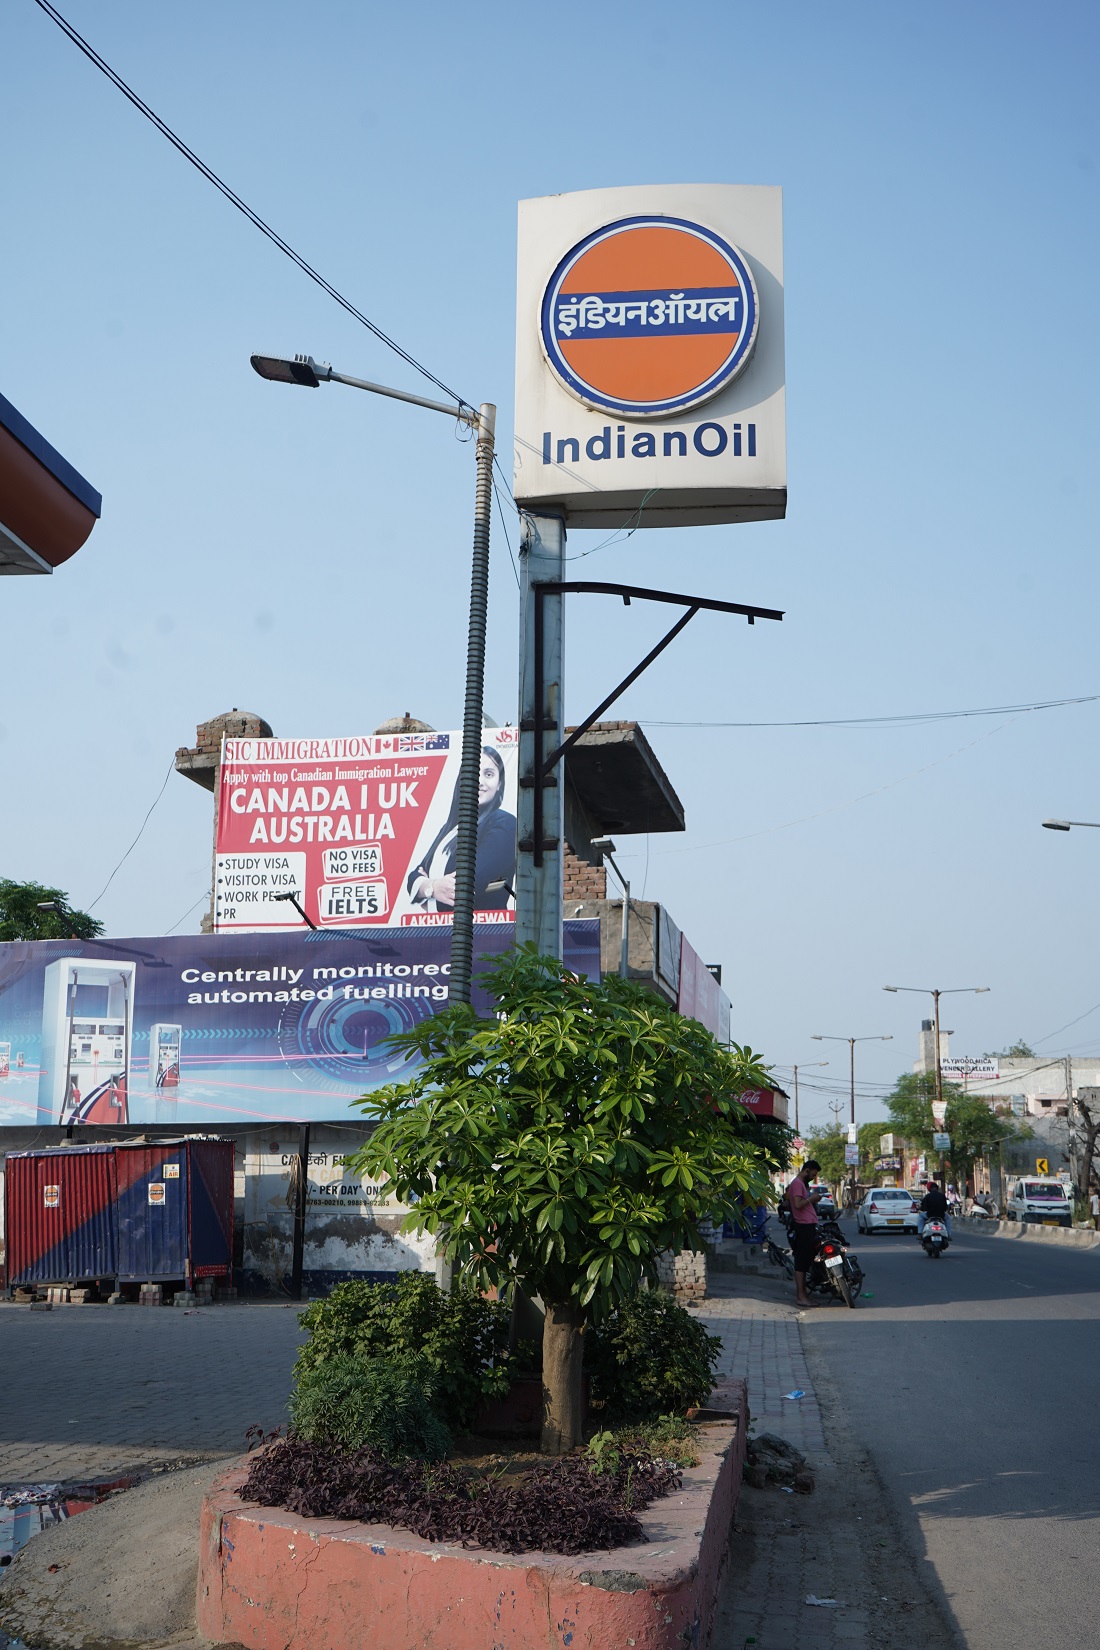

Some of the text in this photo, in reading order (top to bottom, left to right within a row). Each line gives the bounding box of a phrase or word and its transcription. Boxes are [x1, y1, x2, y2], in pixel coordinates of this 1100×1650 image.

[558, 293, 739, 336] इंडियनऑयल
[543, 422, 757, 465] IndianOil
[225, 738, 373, 761] SIC IMMIGRATION
[223, 763, 429, 786] Apply with top Canadian Immigration Lawyer
[230, 785, 351, 814] CANADA
[378, 781, 420, 809] UK
[249, 813, 396, 844] AUSTRALIA
[329, 849, 378, 861] NO VISA
[225, 858, 289, 870] STUDY VISA
[330, 862, 376, 874] NO FEES
[224, 874, 297, 886] VISITOR VISA
[224, 891, 259, 902] WORK
[331, 885, 376, 898] FREE
[223, 908, 236, 919] PR
[328, 898, 379, 915] IELTS
[180, 966, 305, 985] Centrally
[187, 982, 449, 1004] automated fuelling
[319, 1185, 338, 1195] PER
